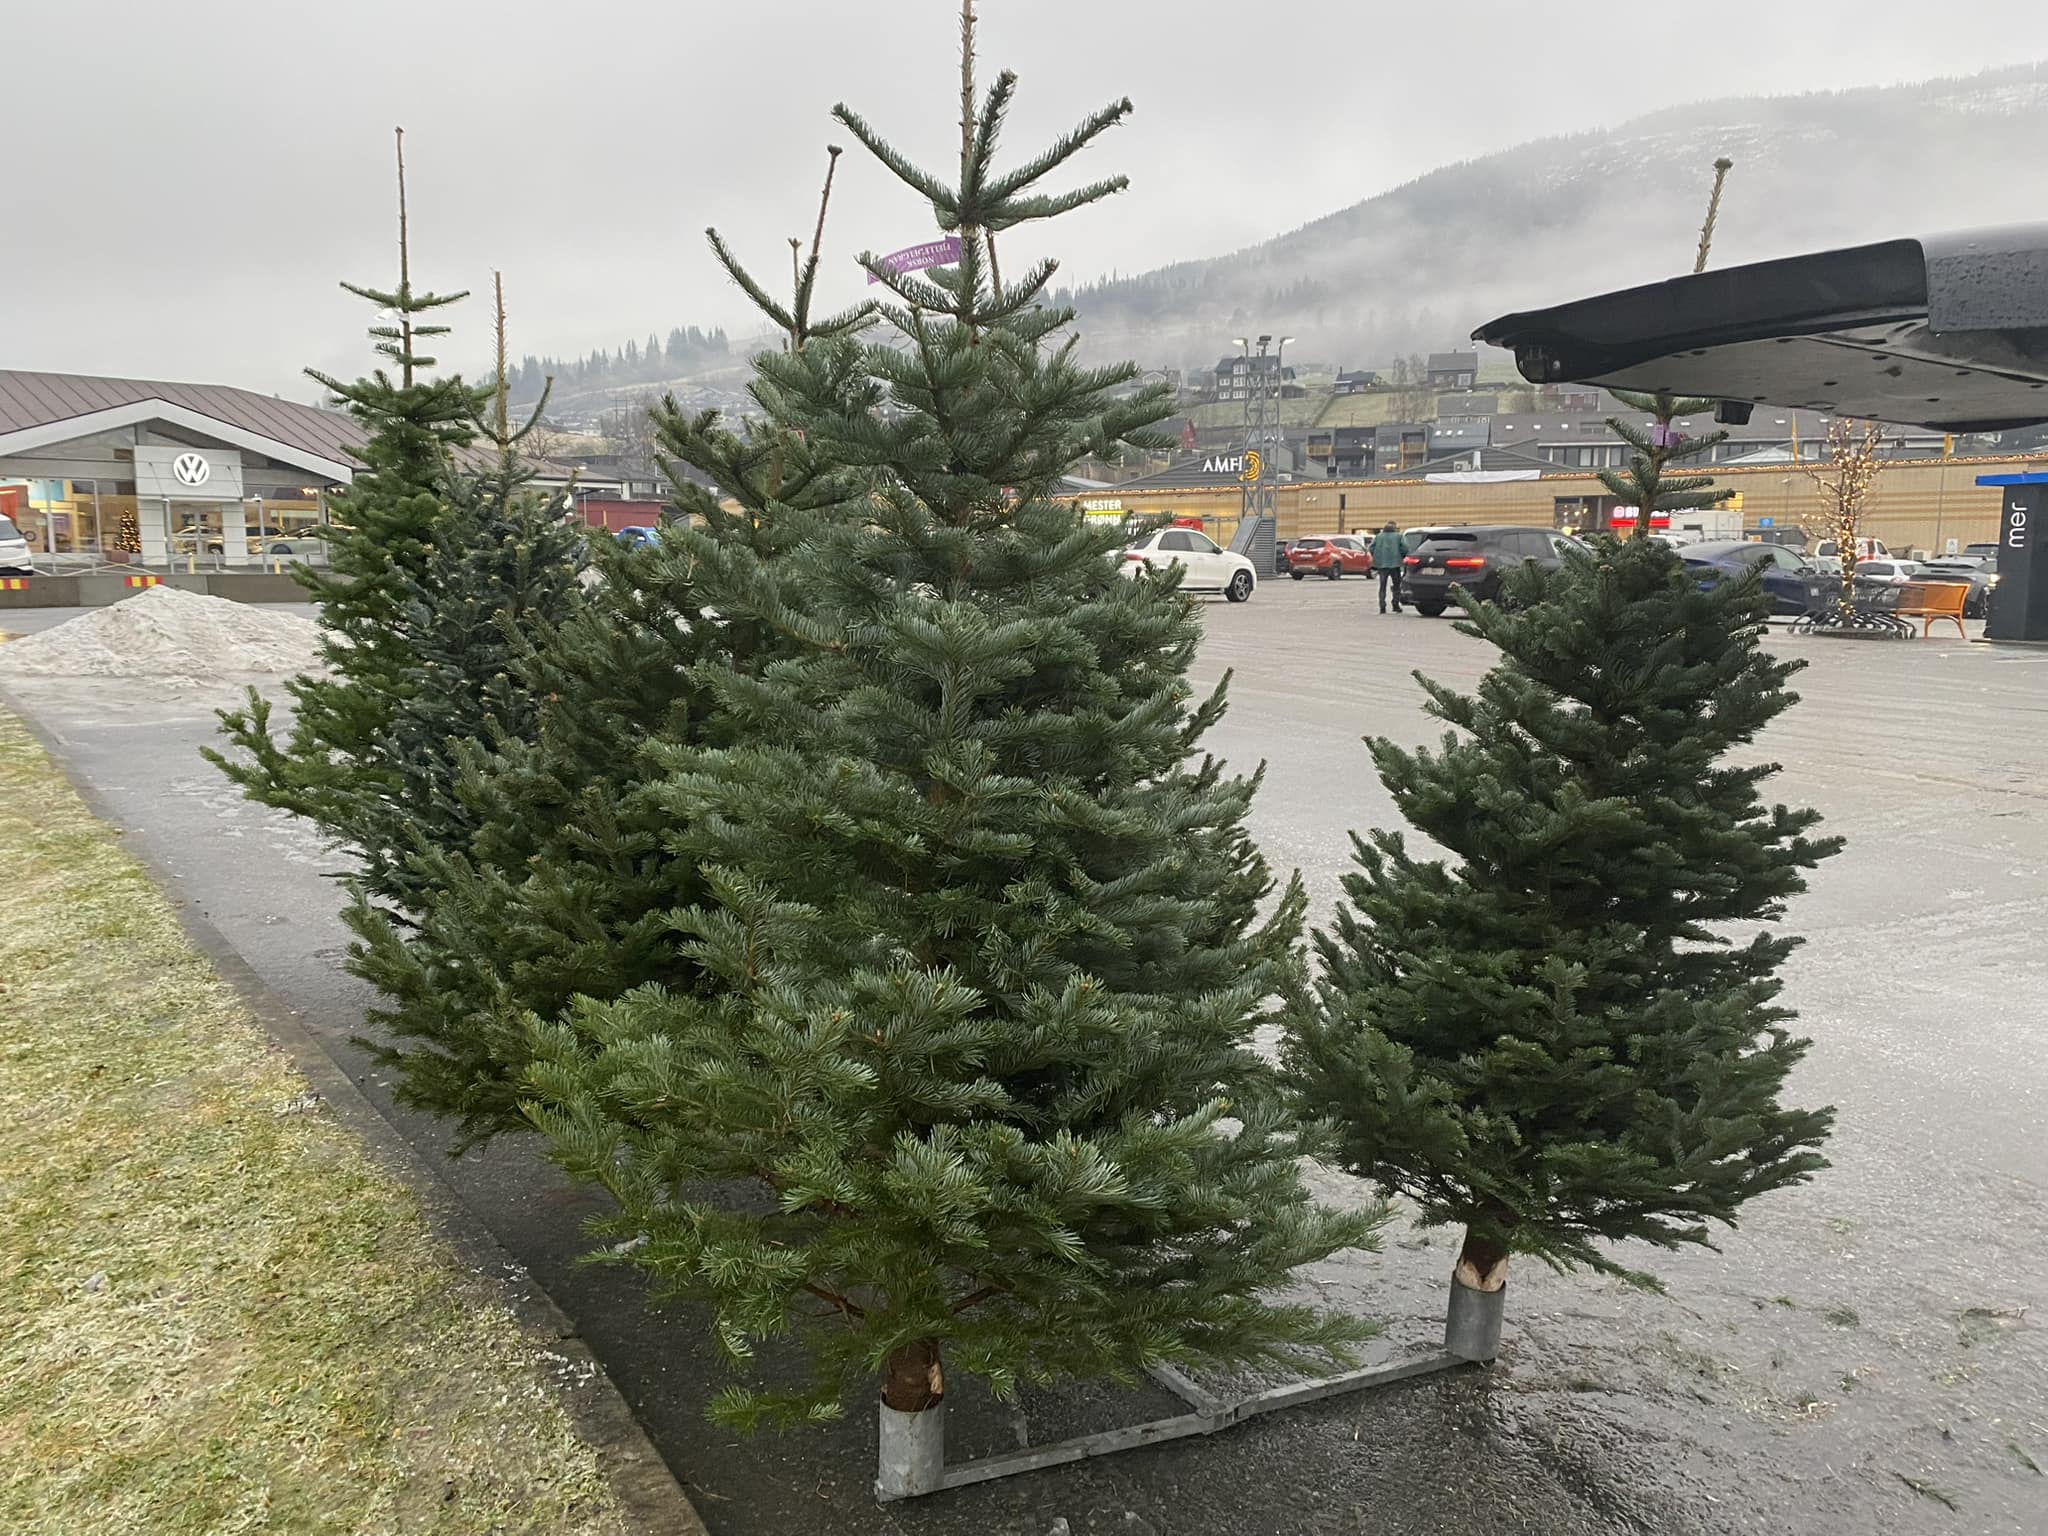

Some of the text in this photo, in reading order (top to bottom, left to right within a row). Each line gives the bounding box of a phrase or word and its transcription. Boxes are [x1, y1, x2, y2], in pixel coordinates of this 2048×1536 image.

[906, 255, 935, 267] NORSK
[174, 453, 209, 486] VW
[1203, 455, 1243, 473] AMFI
[2008, 501, 2028, 548] mer
